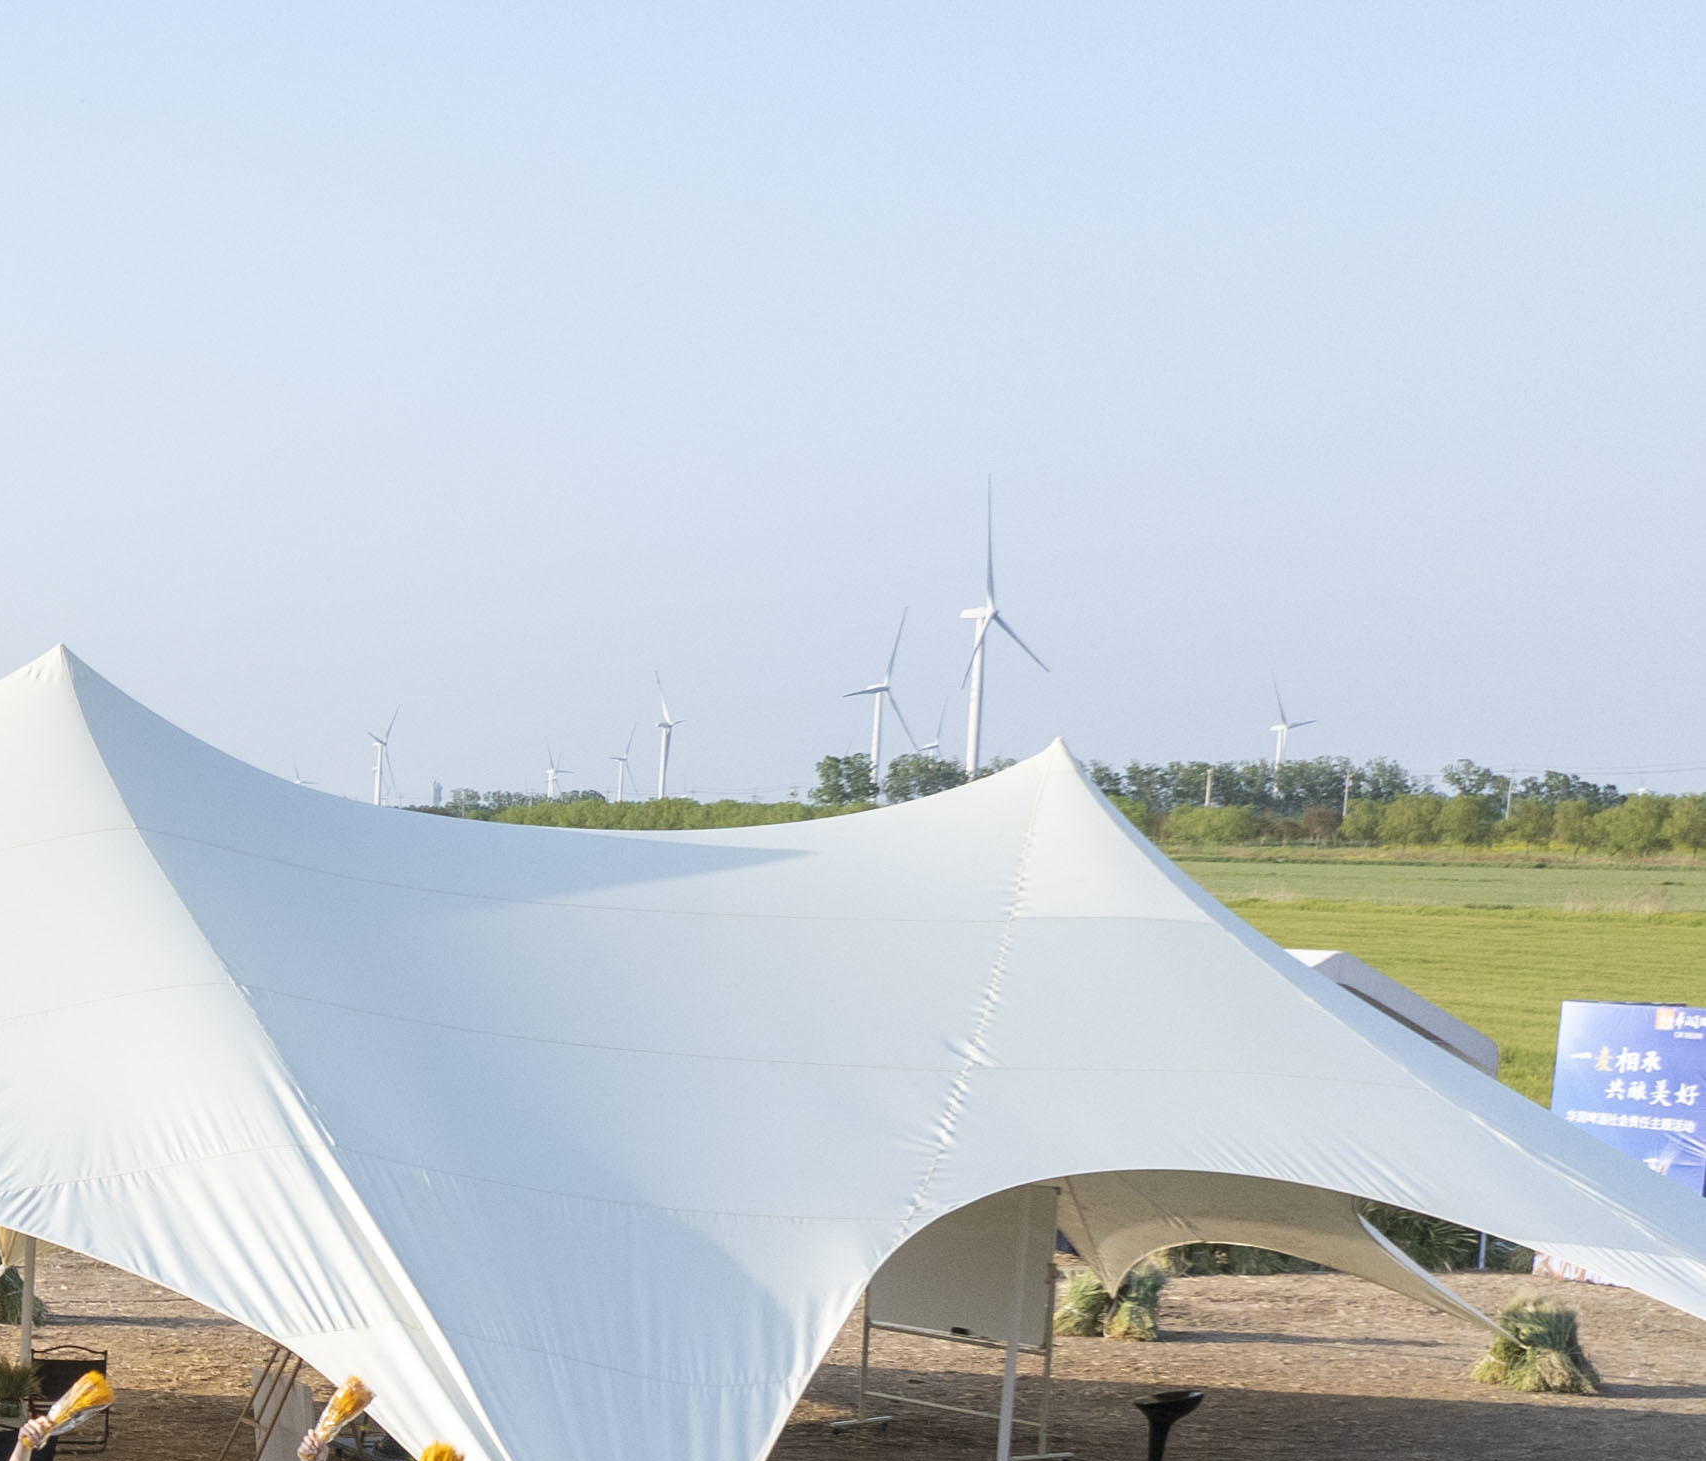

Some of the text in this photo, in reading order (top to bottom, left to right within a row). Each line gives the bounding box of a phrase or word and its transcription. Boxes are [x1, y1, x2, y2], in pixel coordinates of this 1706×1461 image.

[1571, 1046, 1661, 1073] 一麦相承
[1605, 1078, 1700, 1107] 共酿美好
